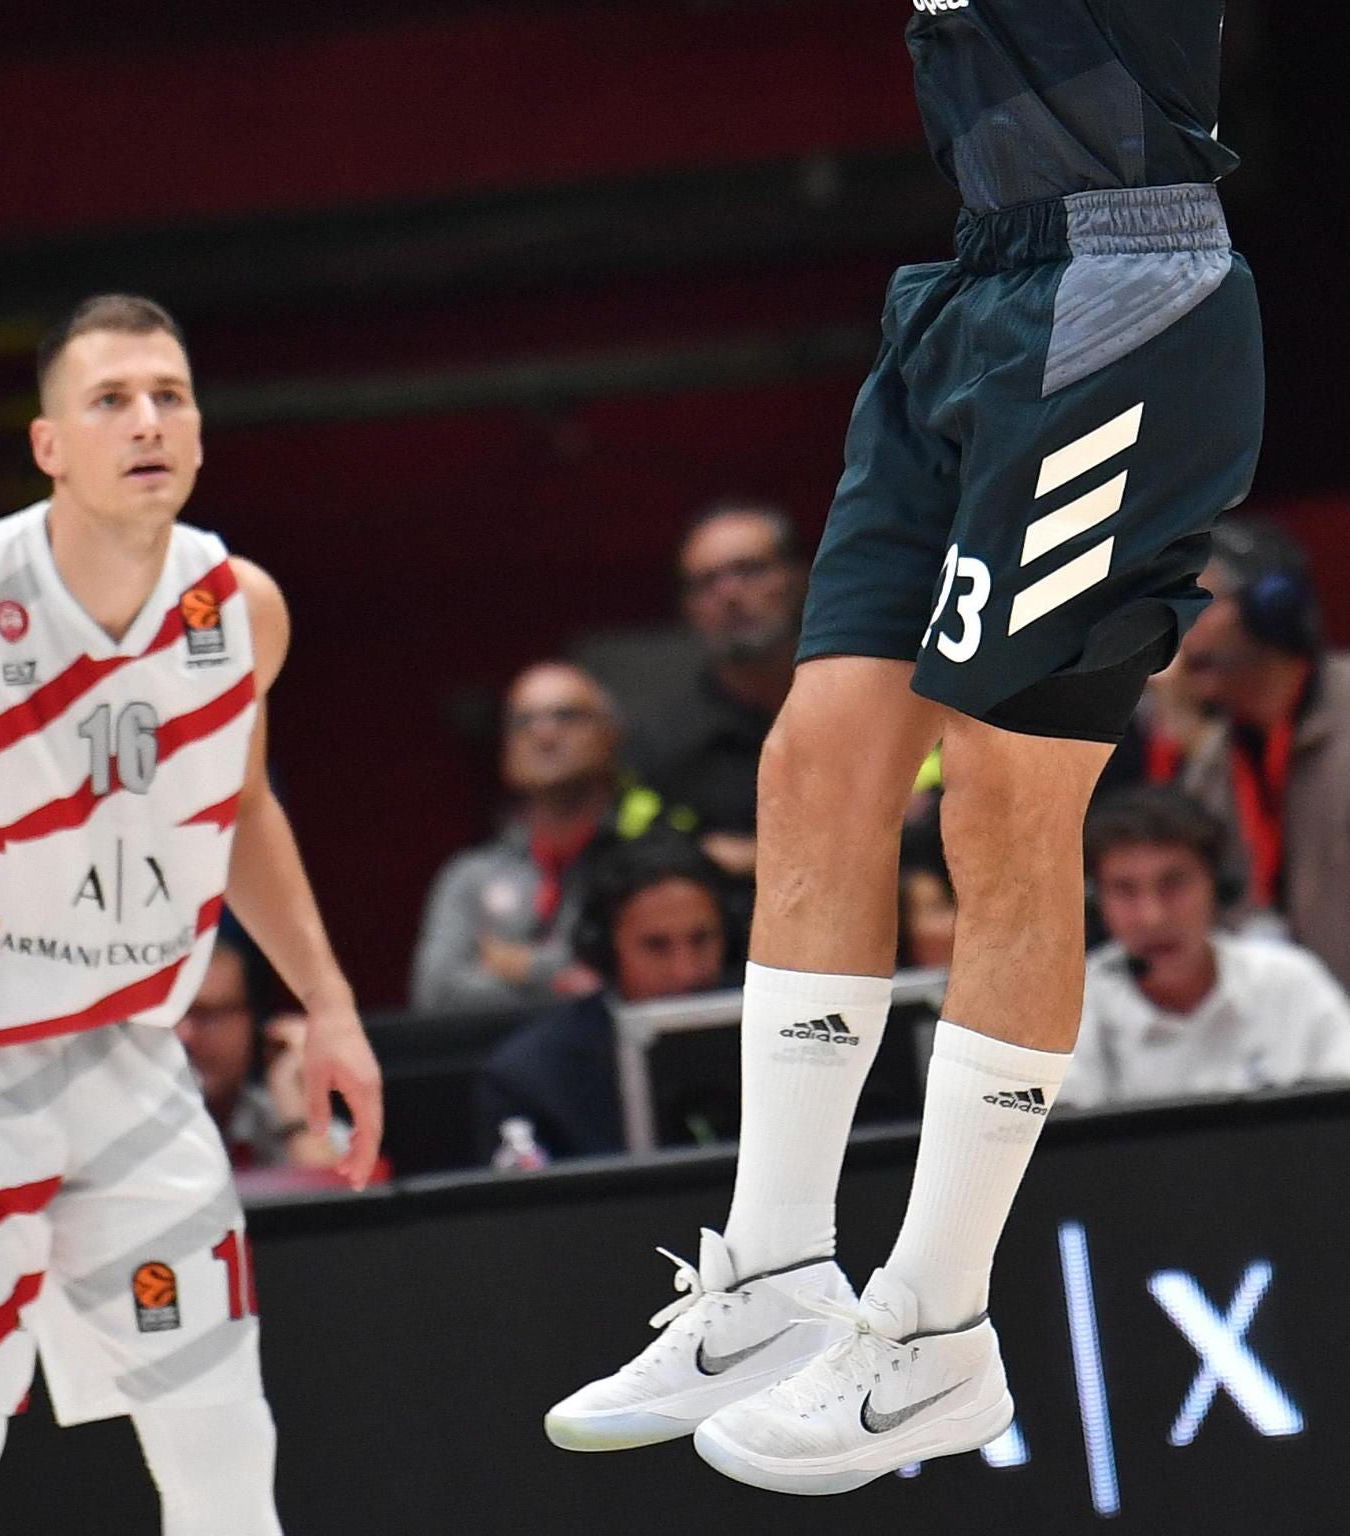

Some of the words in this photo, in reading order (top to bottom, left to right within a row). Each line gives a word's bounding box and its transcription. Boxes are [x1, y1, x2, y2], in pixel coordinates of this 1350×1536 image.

[78, 701, 158, 796] 16
[2, 932, 101, 969] ARMANI
[779, 1027, 859, 1046] adidas
[982, 1094, 1047, 1116] adidas
[211, 1229, 259, 1321] 1
